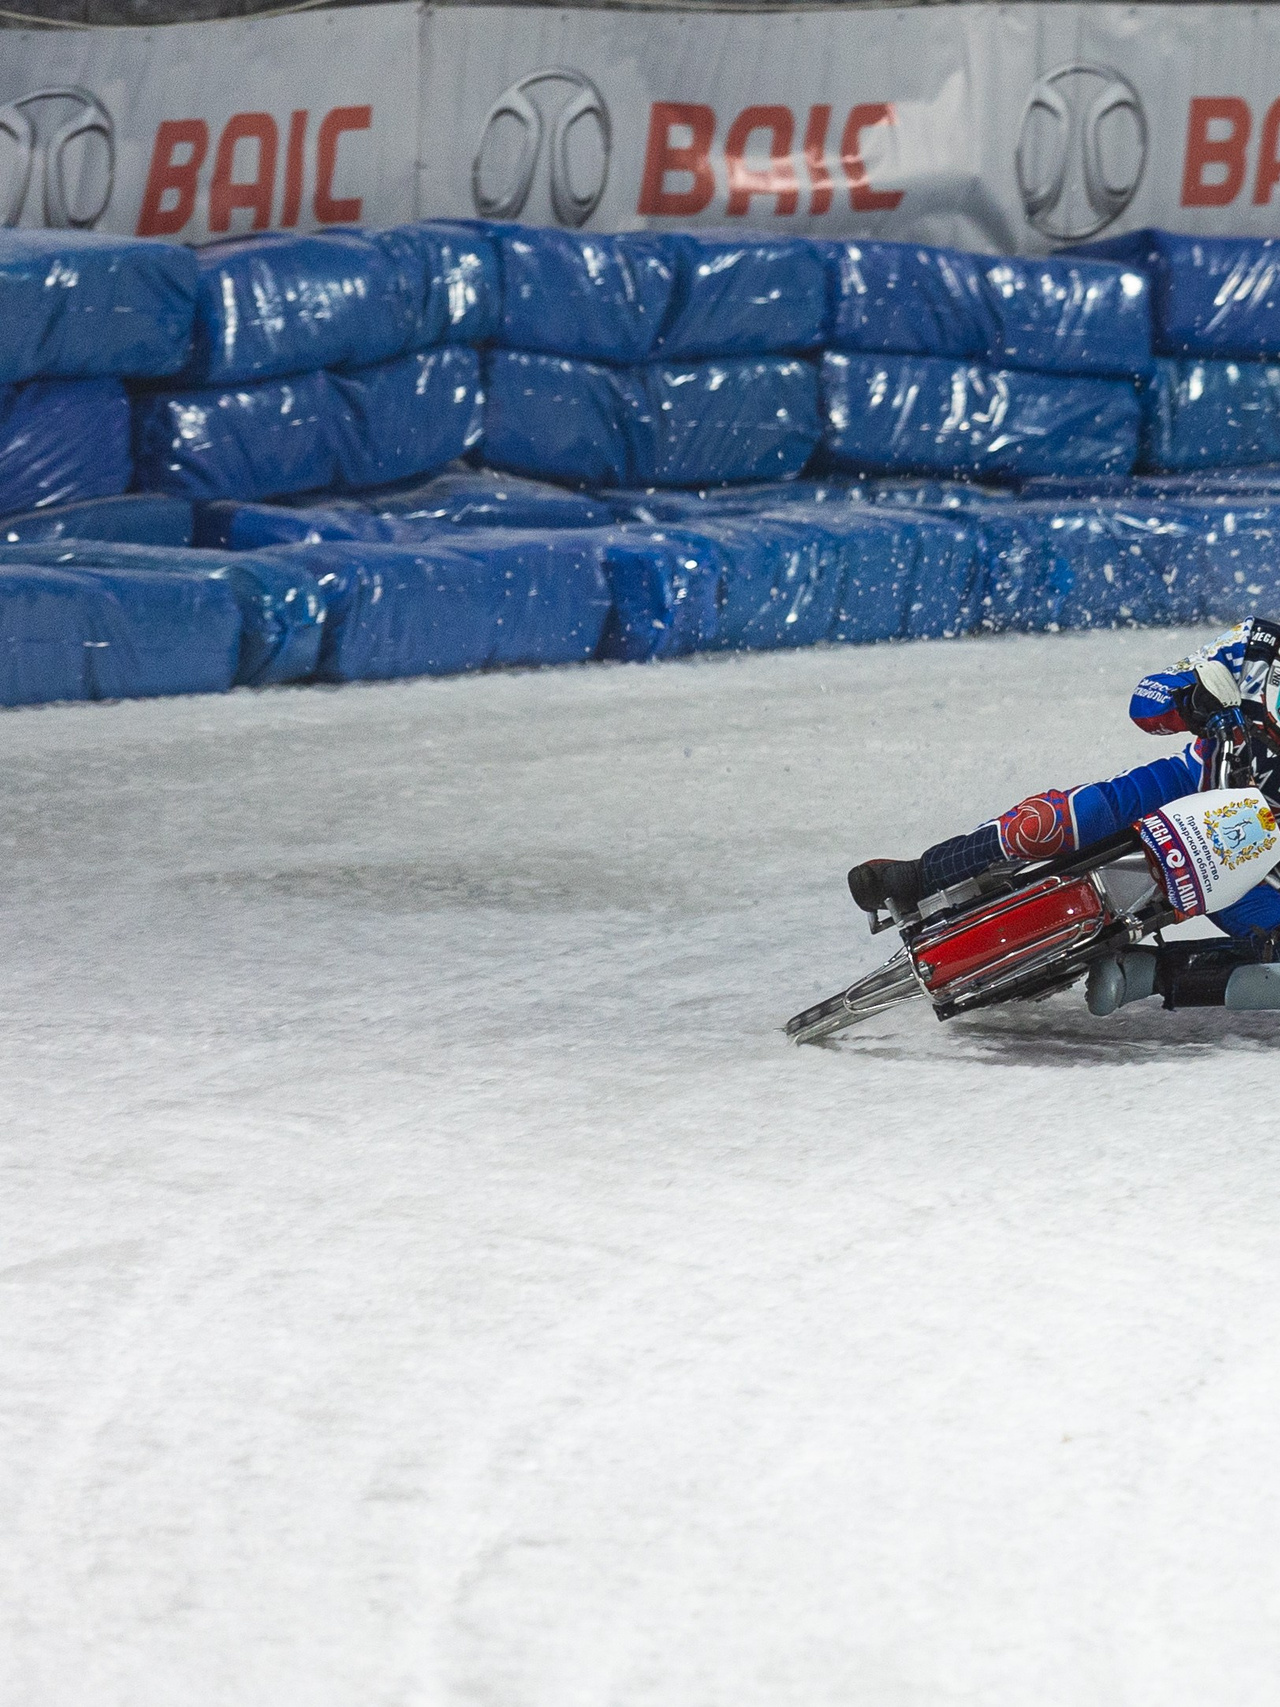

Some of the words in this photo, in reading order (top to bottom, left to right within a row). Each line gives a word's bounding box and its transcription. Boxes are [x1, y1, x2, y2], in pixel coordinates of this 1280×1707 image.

[134, 104, 373, 237] BAIC
[637, 102, 905, 217] BAIC
[1252, 631, 1277, 647] MEGA
[1143, 815, 1173, 846] MEGA
[1174, 874, 1199, 911] LADA
[1172, 813, 1199, 857] Самарской
[1196, 857, 1213, 893] области
[1186, 815, 1220, 881] Правительство
